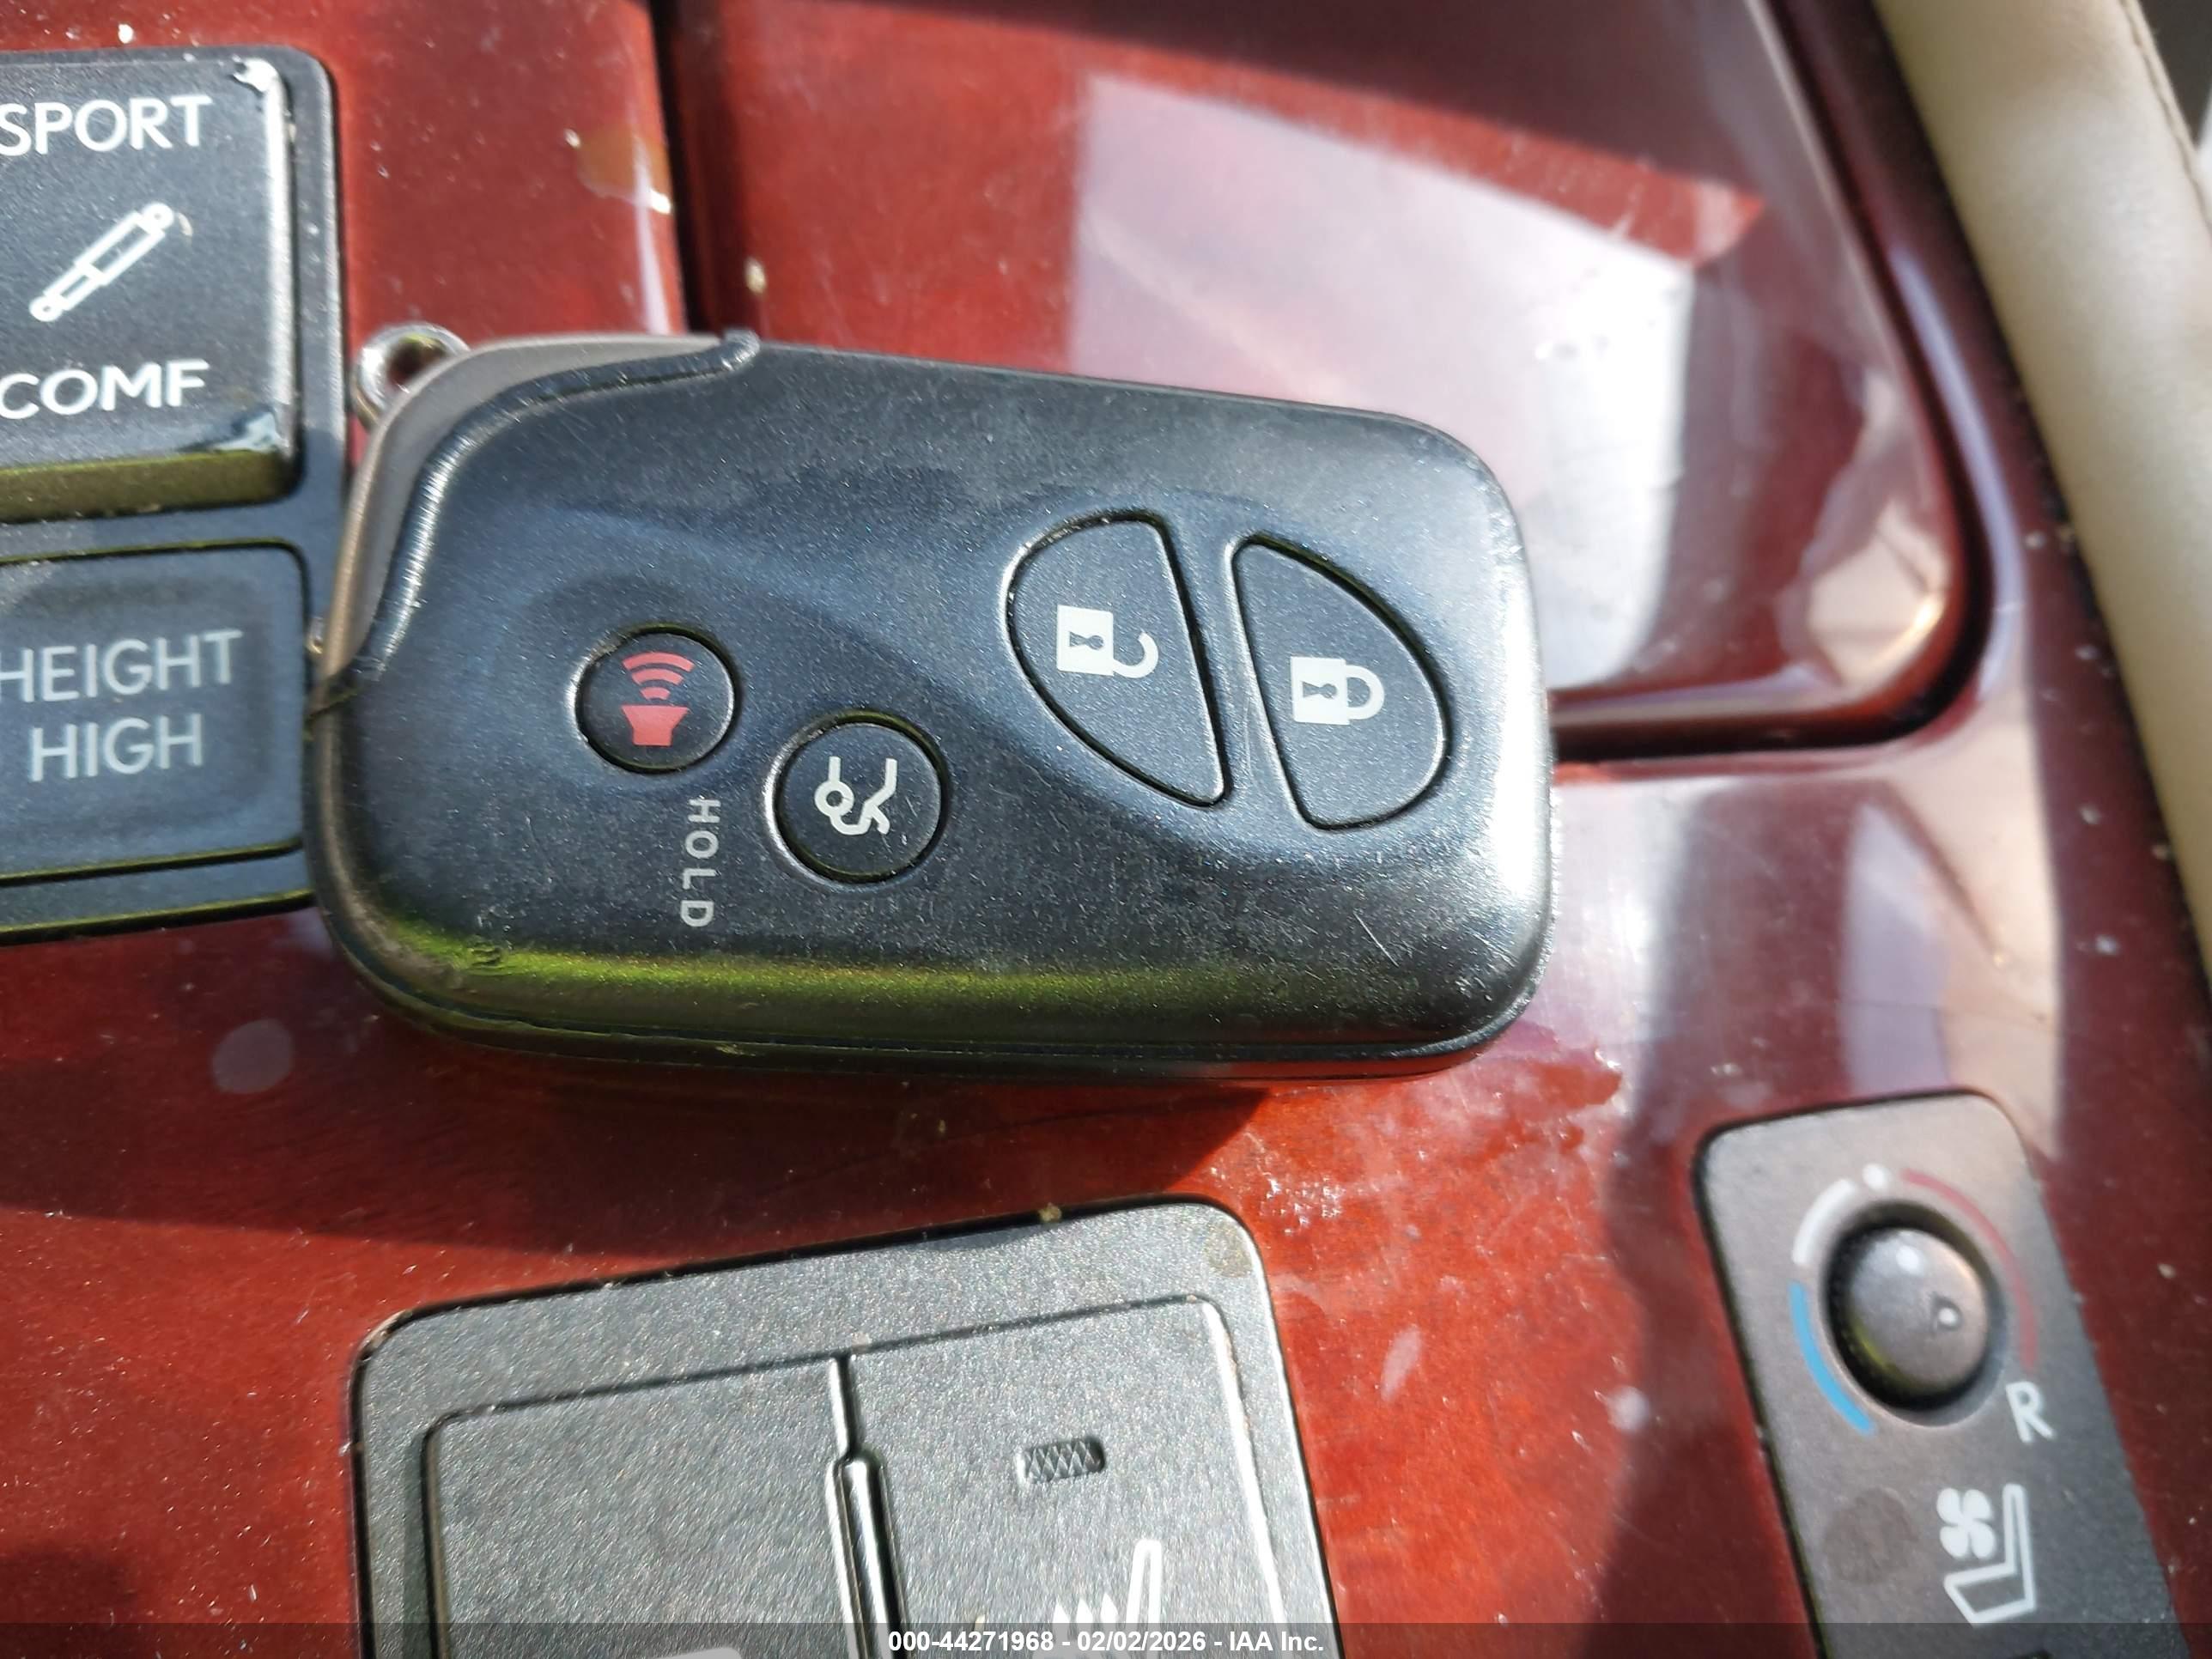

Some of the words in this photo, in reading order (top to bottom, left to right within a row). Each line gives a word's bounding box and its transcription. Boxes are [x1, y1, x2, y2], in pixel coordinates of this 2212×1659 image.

[0, 94, 213, 157] SPORT
[0, 359, 210, 419] COMF
[0, 629, 242, 702] HEIGHT
[30, 713, 203, 782] HIGH
[680, 797, 721, 928] HOLD
[2005, 1381, 2056, 1443] R
